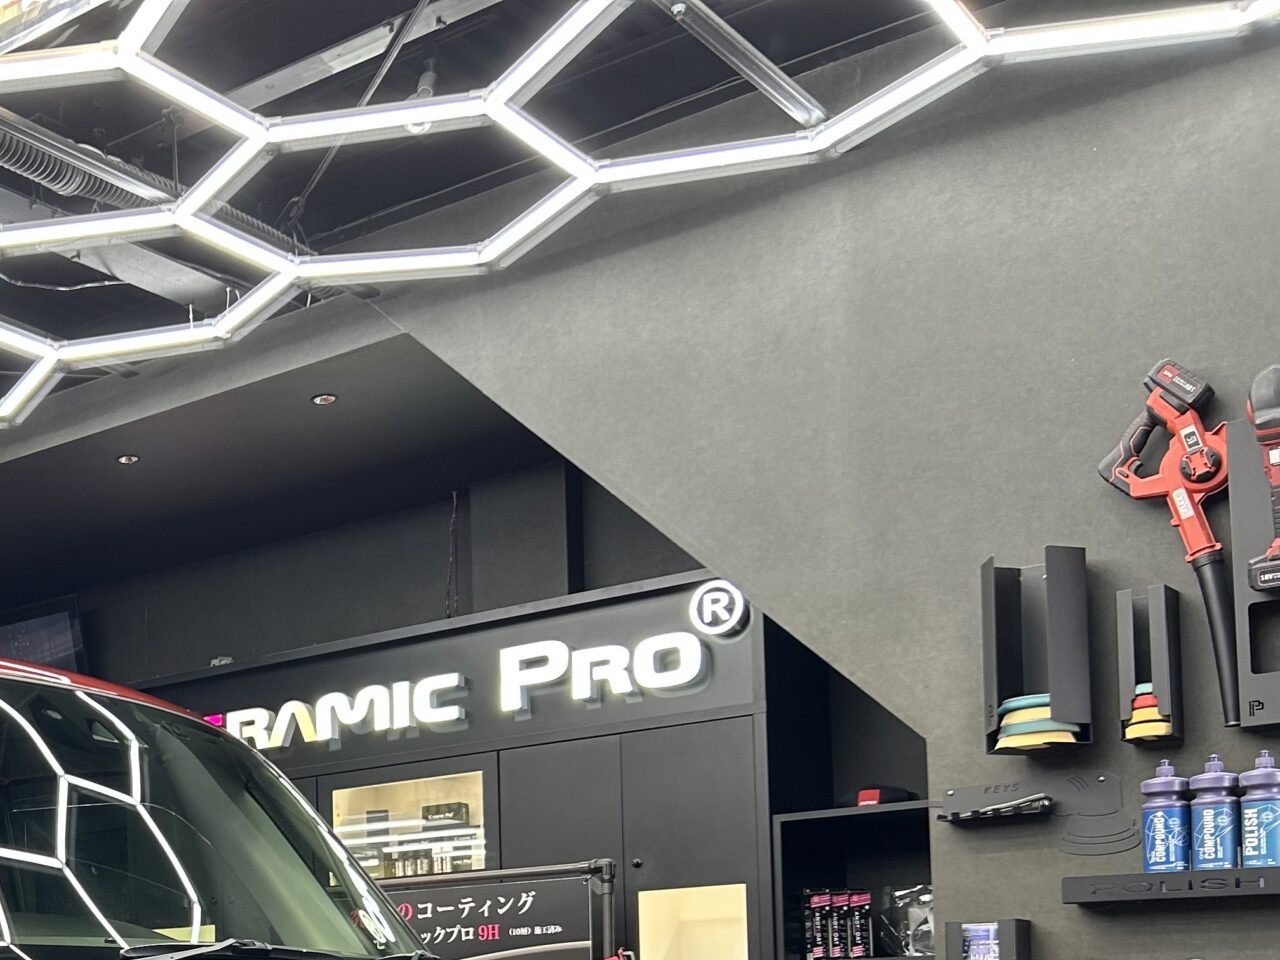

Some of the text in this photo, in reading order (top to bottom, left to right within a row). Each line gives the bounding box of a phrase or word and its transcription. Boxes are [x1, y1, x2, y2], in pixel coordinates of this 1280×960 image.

[203, 672, 466, 750] RAMIC
[1203, 809, 1216, 860] COMPOUND
[1244, 808, 1259, 856] POLISH
[1090, 877, 1265, 897] POLISH
[477, 924, 501, 941] 9H
